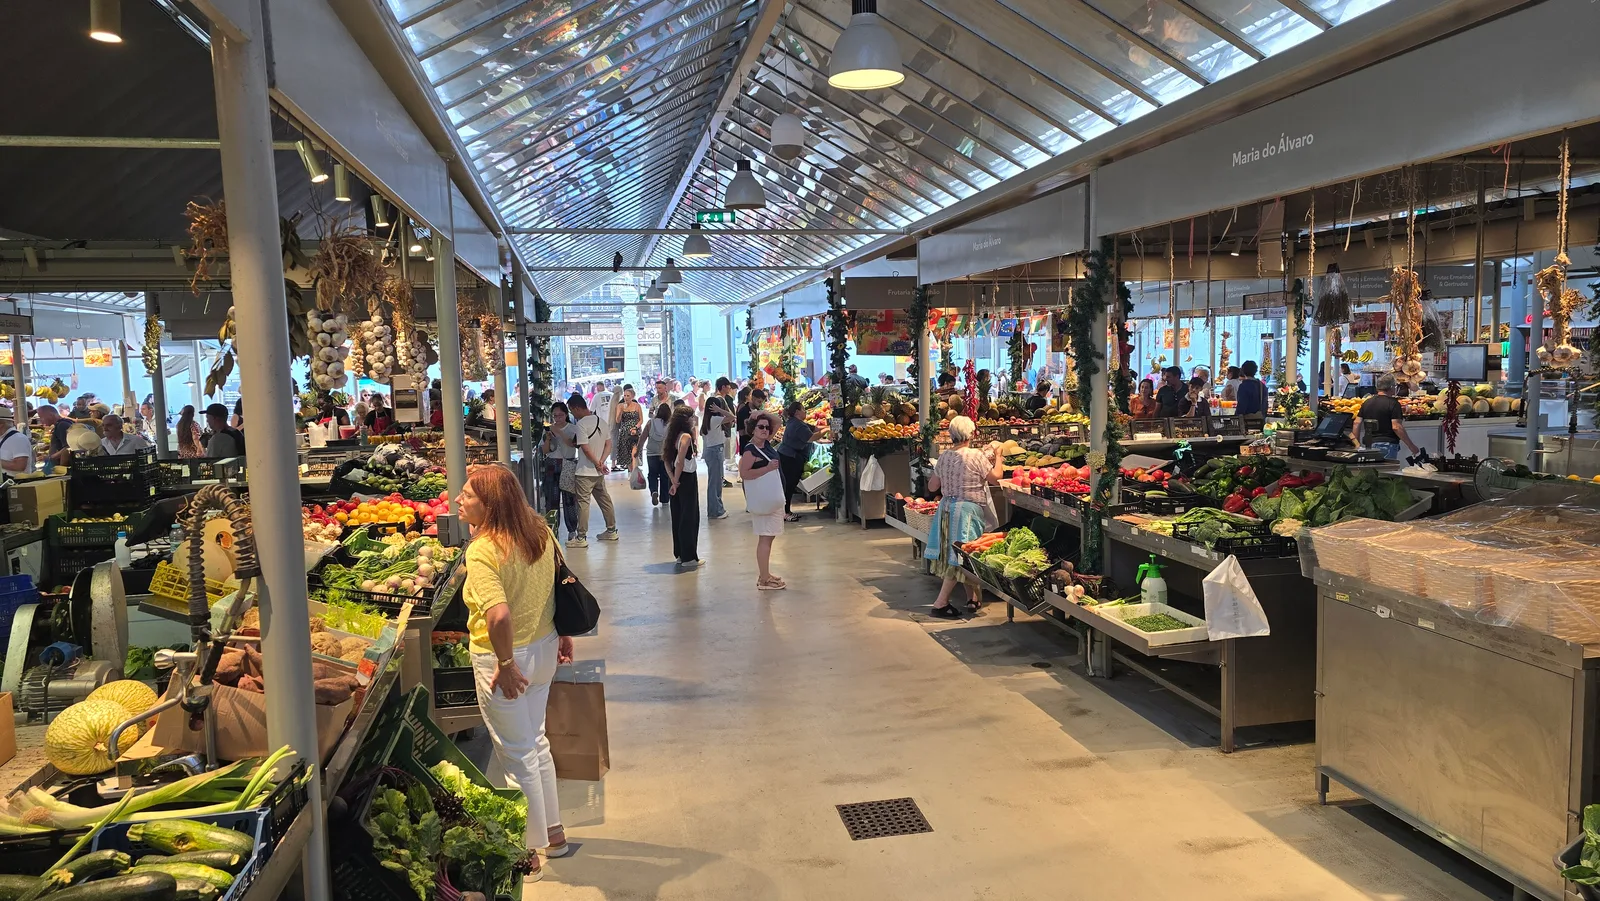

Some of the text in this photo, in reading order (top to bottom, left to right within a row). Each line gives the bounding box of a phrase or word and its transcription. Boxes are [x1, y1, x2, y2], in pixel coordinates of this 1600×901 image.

[1232, 132, 1314, 167] Maria do Álvaro
[1449, 273, 1474, 281] Ermelinda
[887, 288, 911, 296] Frutaria
[637, 330, 662, 340] olhão
